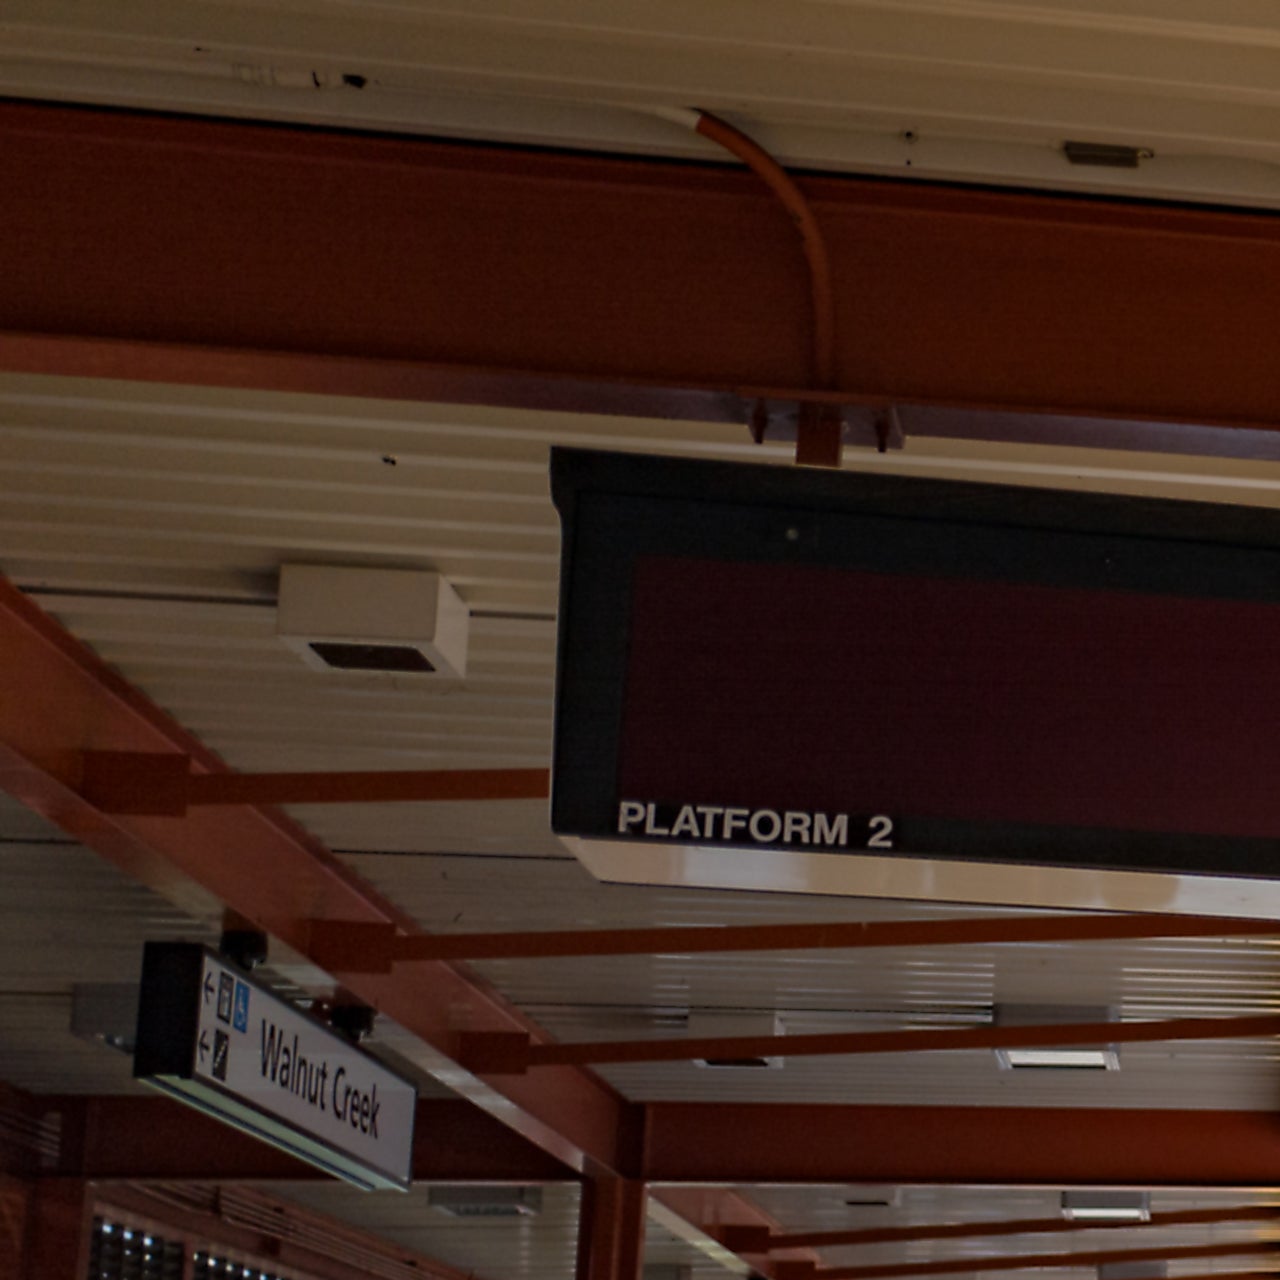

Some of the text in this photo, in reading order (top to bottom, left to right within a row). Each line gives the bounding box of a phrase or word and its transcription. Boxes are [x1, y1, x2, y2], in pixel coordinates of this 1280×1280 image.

[617, 800, 893, 847] PLATFORM 2
[260, 1017, 380, 1140] Walnut Creek
